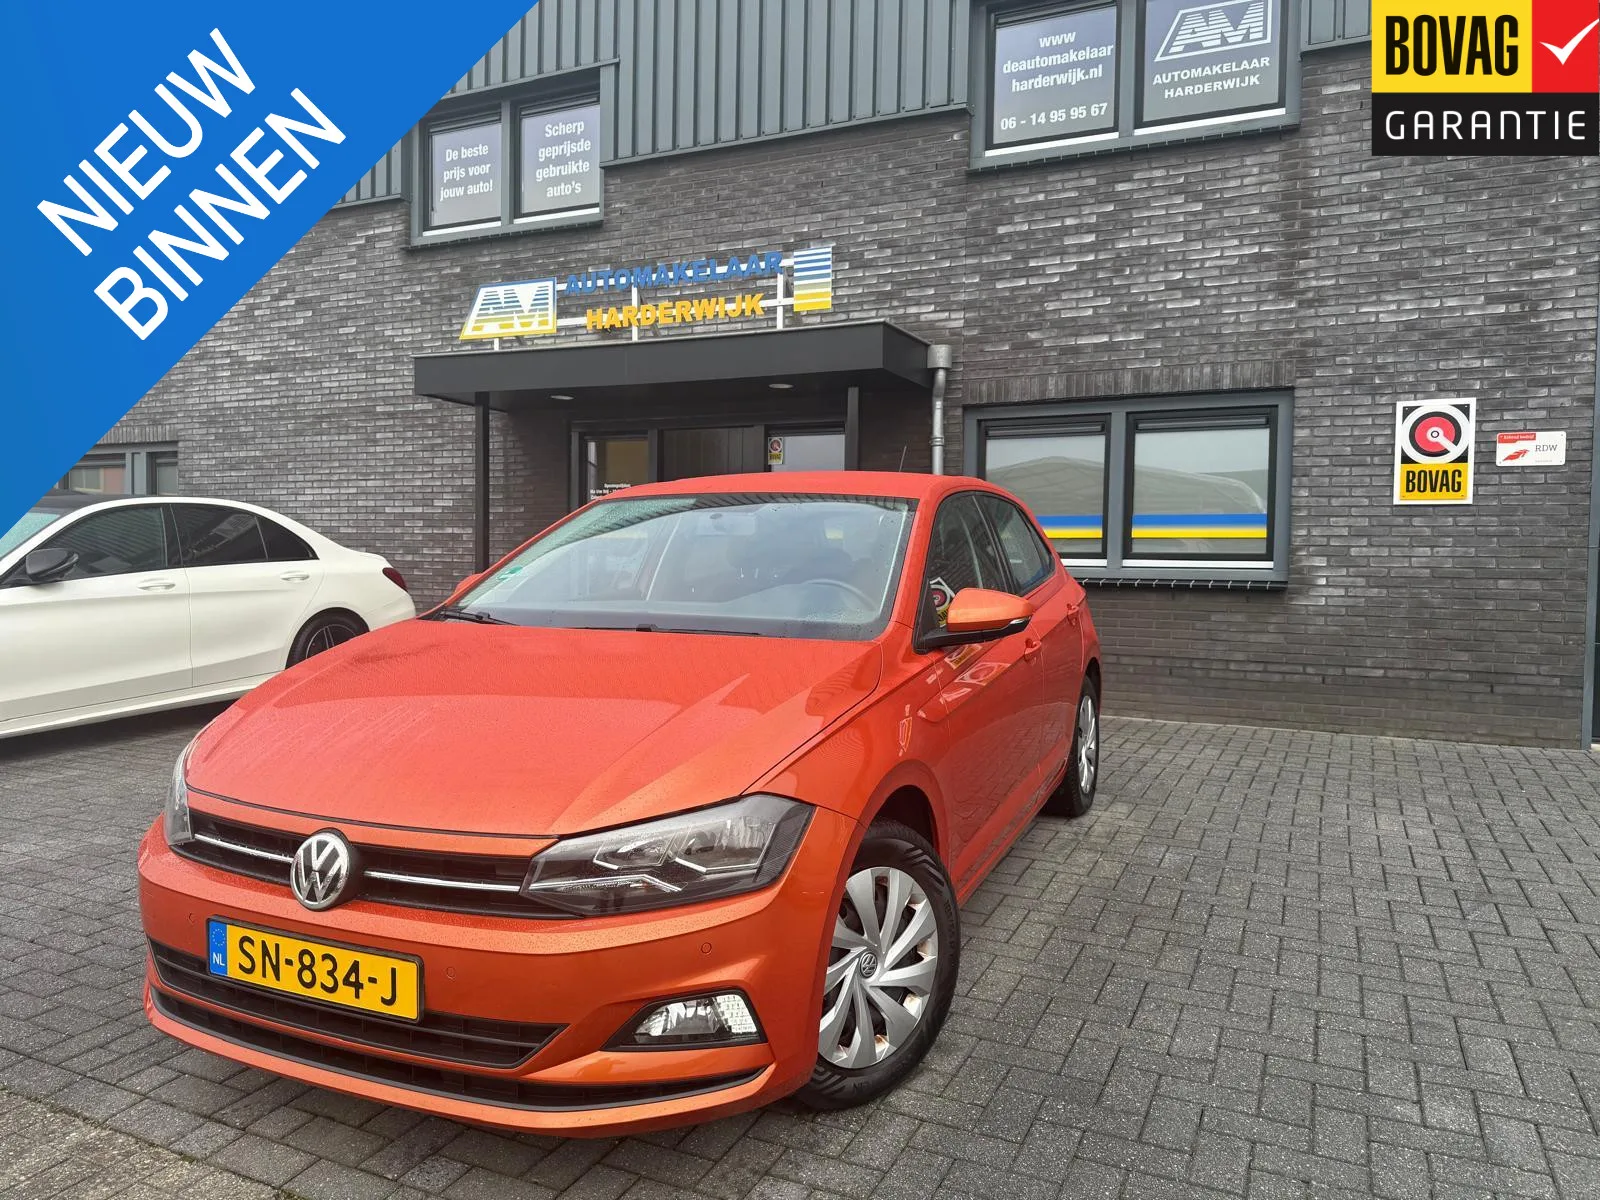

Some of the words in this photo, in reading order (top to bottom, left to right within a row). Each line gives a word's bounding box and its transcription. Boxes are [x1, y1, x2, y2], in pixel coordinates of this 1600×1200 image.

[1039, 31, 1077, 48] www
[1002, 43, 1114, 74] deautomakelaar
[1011, 64, 1103, 93] harderwijk.nl
[1152, 56, 1271, 86] AUTOMAKELAAR
[1164, 73, 1260, 99] HARDERWIJK
[1000, 116, 1017, 131] 06
[1030, 112, 1046, 126] 14
[1049, 109, 1066, 124] 95
[1069, 106, 1087, 121] 95
[1090, 102, 1108, 117] 67
[544, 121, 585, 138] Scherp
[446, 149, 458, 162] De
[461, 144, 488, 159] beste
[538, 138, 591, 161] geprijsde
[443, 166, 465, 183] prijs
[468, 163, 491, 176] voor
[536, 160, 590, 182] gebruikte
[440, 186, 464, 201] jouw
[467, 180, 493, 195] auto!
[546, 181, 581, 198] auto's
[565, 250, 783, 295] AUTOMAKELAAR
[586, 293, 765, 330] HARDERWIJK
[1535, 444, 1558, 452] RDW
[1405, 469, 1462, 494] BOVAG
[212, 952, 226, 966] NL
[238, 935, 397, 1007] SN-834-J
